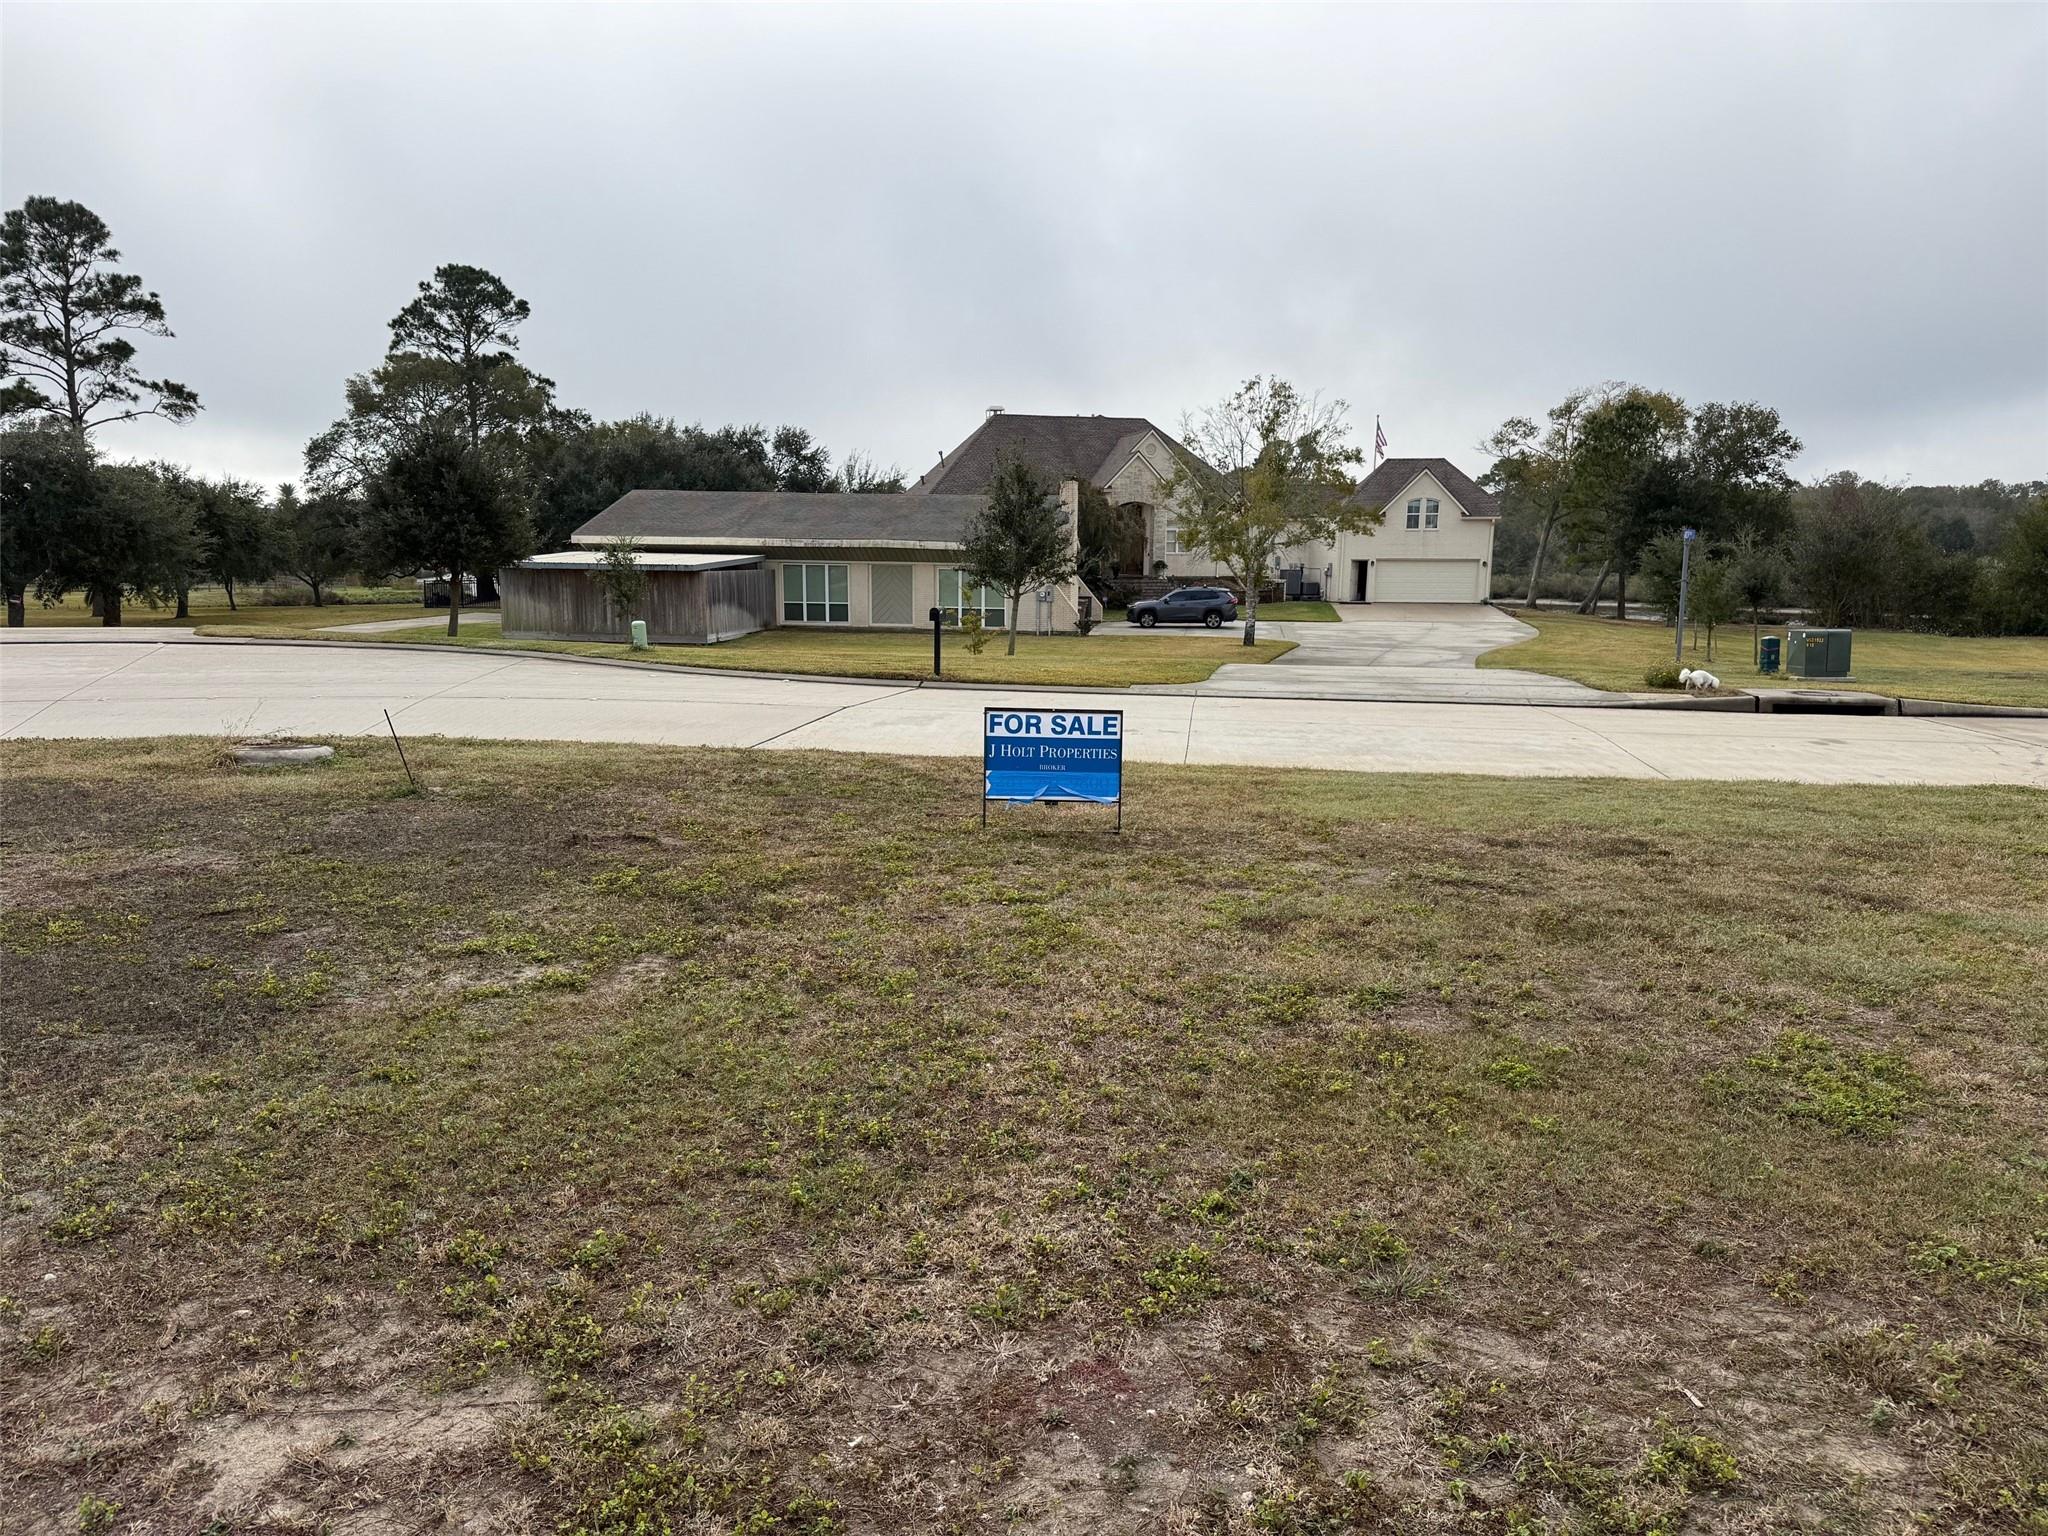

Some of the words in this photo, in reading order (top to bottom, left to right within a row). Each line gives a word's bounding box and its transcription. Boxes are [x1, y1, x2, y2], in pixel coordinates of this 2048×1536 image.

[989, 713, 1042, 734] FOR
[1050, 715, 1118, 736] SALE
[988, 744, 996, 758] J
